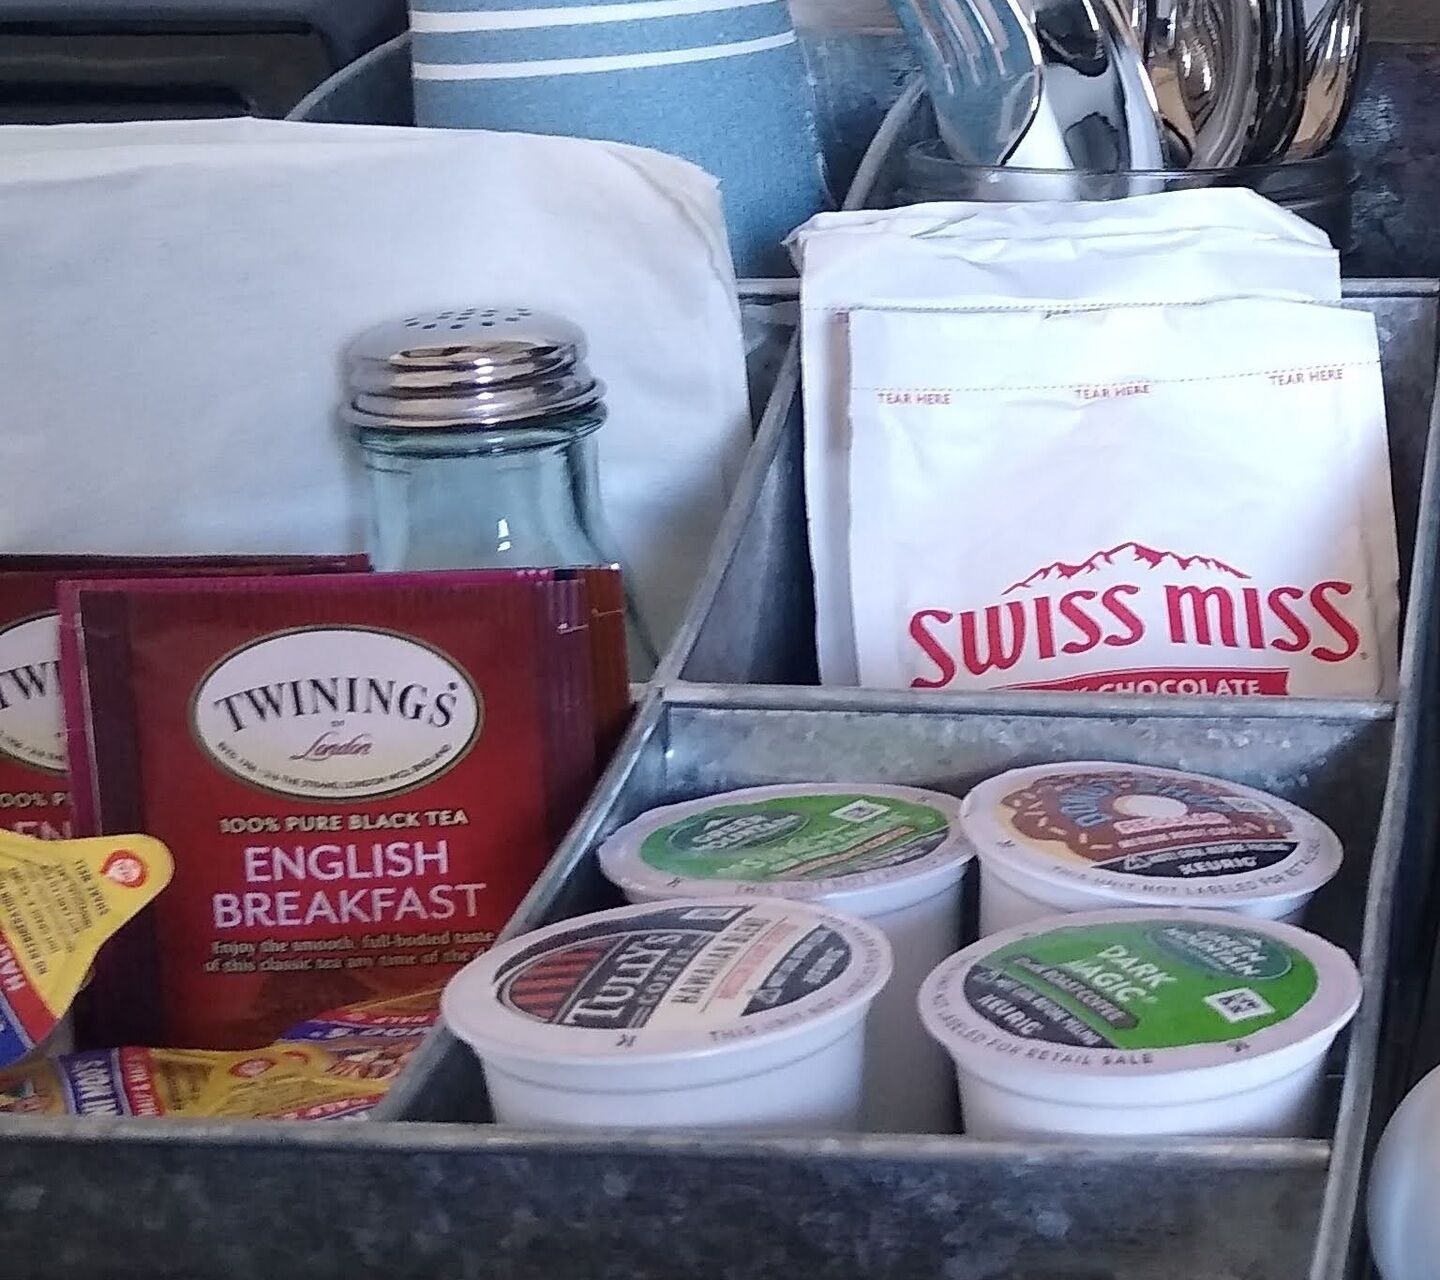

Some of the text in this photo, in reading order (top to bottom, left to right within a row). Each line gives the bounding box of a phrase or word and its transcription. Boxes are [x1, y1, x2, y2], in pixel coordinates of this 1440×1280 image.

[1268, 368, 1344, 386] TEAR HERE
[877, 392, 951, 406] TEAR HERE
[1075, 383, 1150, 401] TEAR HERE
[909, 581, 1361, 689] SWISS MISS
[213, 676, 457, 733] TWININGS
[290, 732, 373, 761] London
[0, 791, 48, 808] 00%
[285, 814, 343, 832] PURE
[348, 811, 421, 830] BLACK
[425, 809, 469, 827] TEA
[244, 839, 449, 882] ENGLISH
[212, 882, 487, 929] BREAKFAST
[1097, 945, 1177, 988] DARK
[977, 994, 1042, 1035] KEURIG
[1025, 1047, 1091, 1066] RETAIL
[1102, 1053, 1154, 1066] SALE
